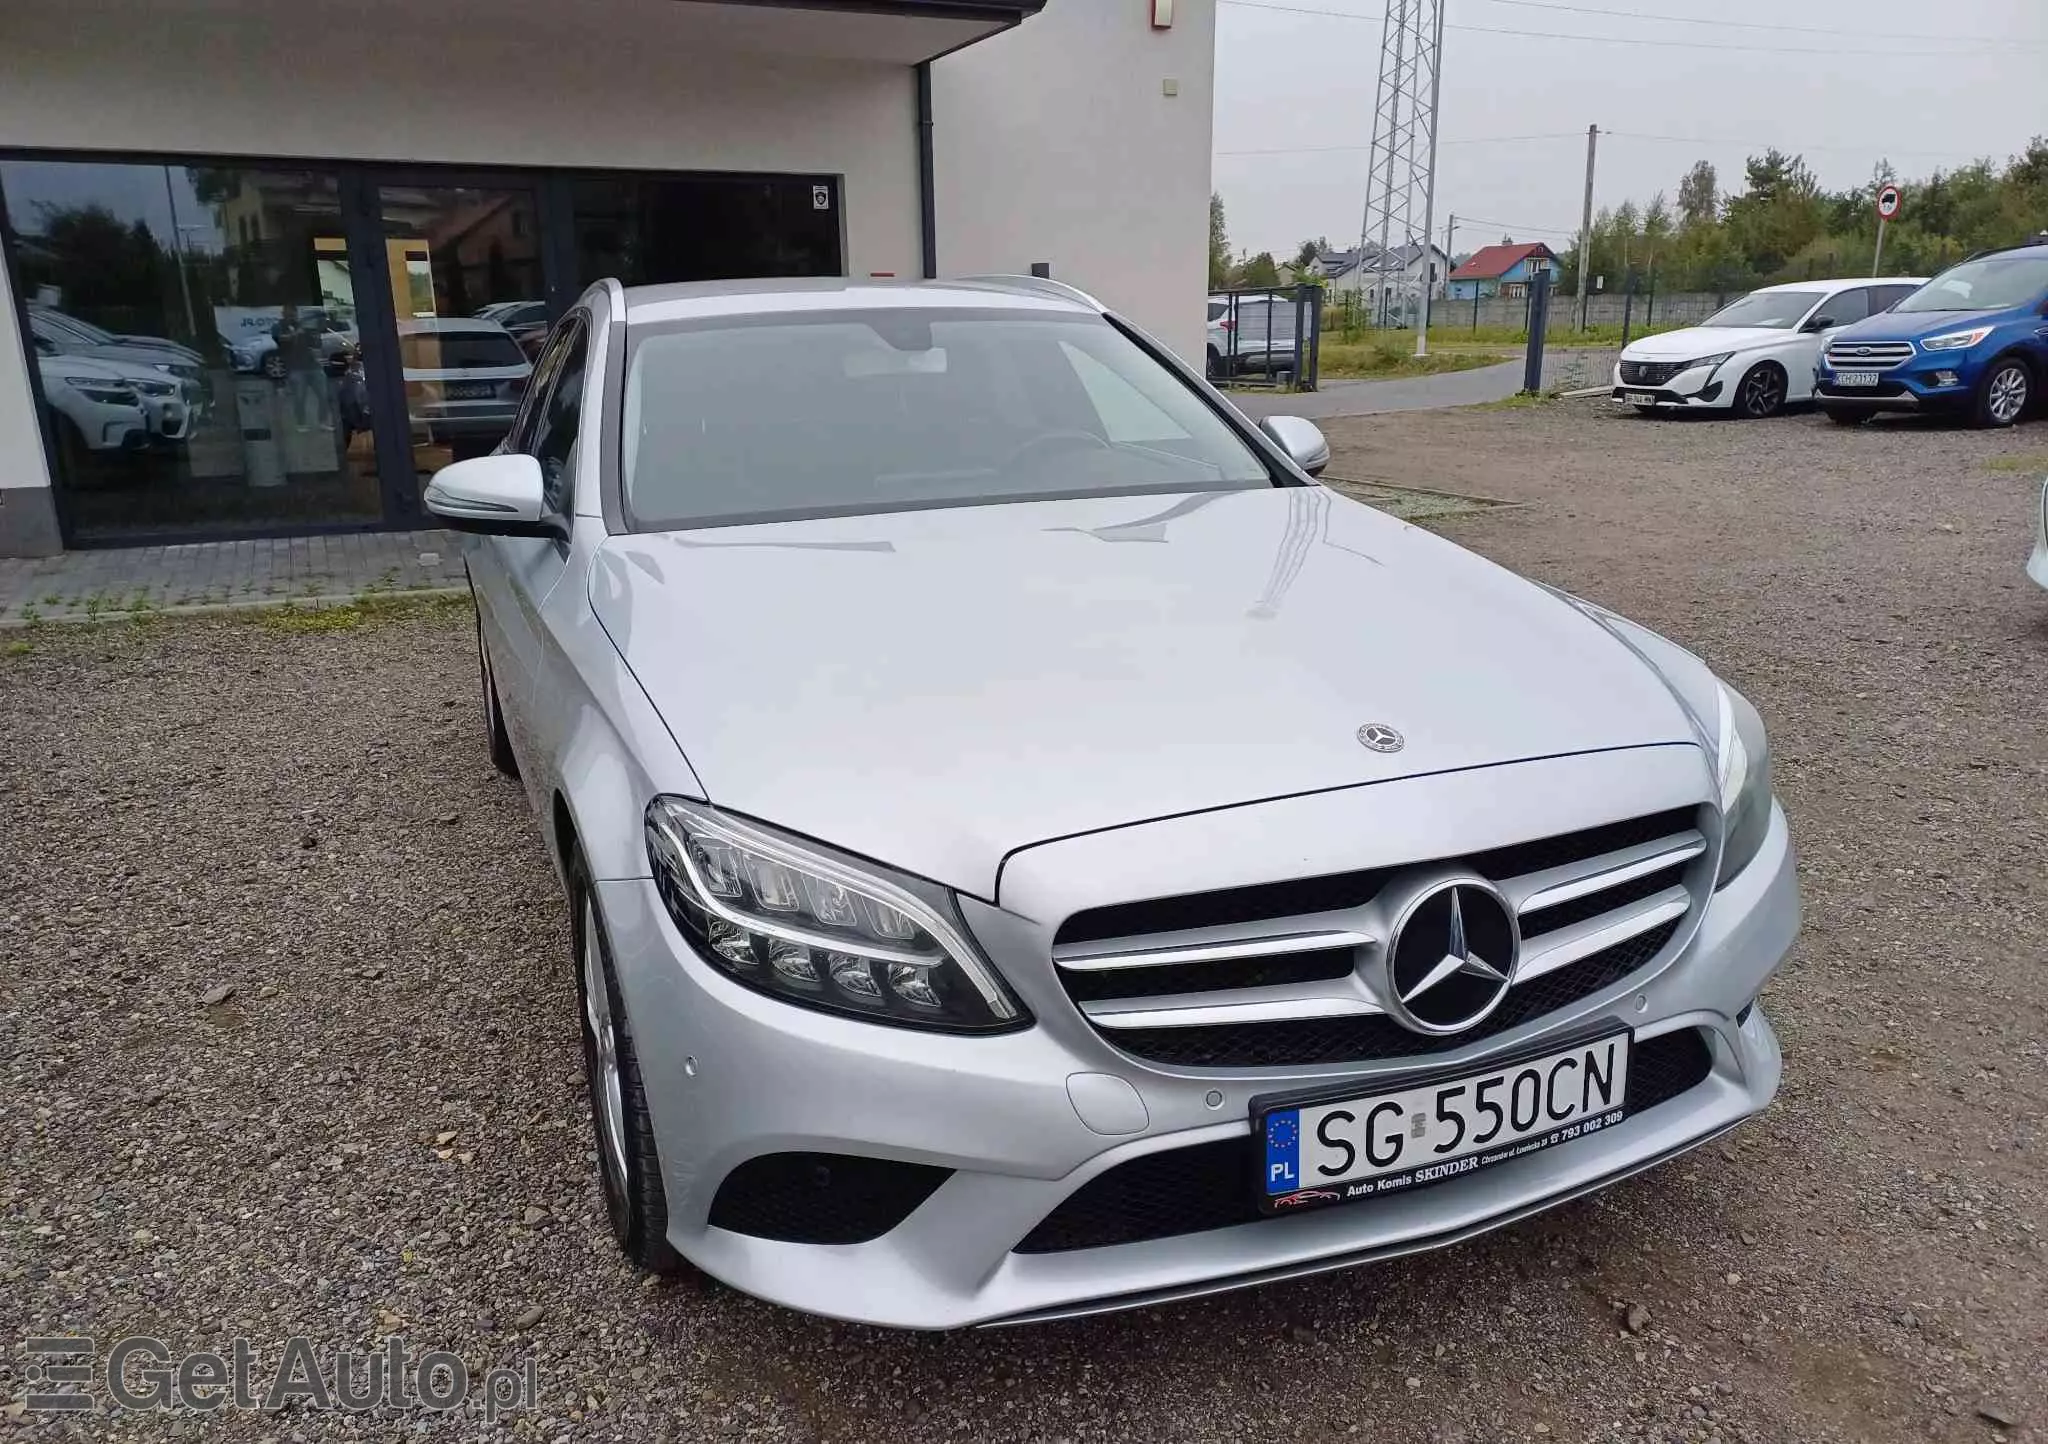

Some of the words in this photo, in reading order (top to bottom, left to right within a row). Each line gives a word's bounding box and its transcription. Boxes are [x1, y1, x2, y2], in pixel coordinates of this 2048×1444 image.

[1317, 1101, 1404, 1177] SG
[1433, 1043, 1615, 1154] 550CN
[1347, 1182, 1374, 1197] Auto
[1377, 1175, 1412, 1192] Komis
[1414, 1156, 1479, 1184] SKINDER
[1560, 1125, 1580, 1142] 793
[1583, 1118, 1602, 1134] 002
[1604, 1110, 1623, 1126] 309
[1270, 1162, 1294, 1182] PL
